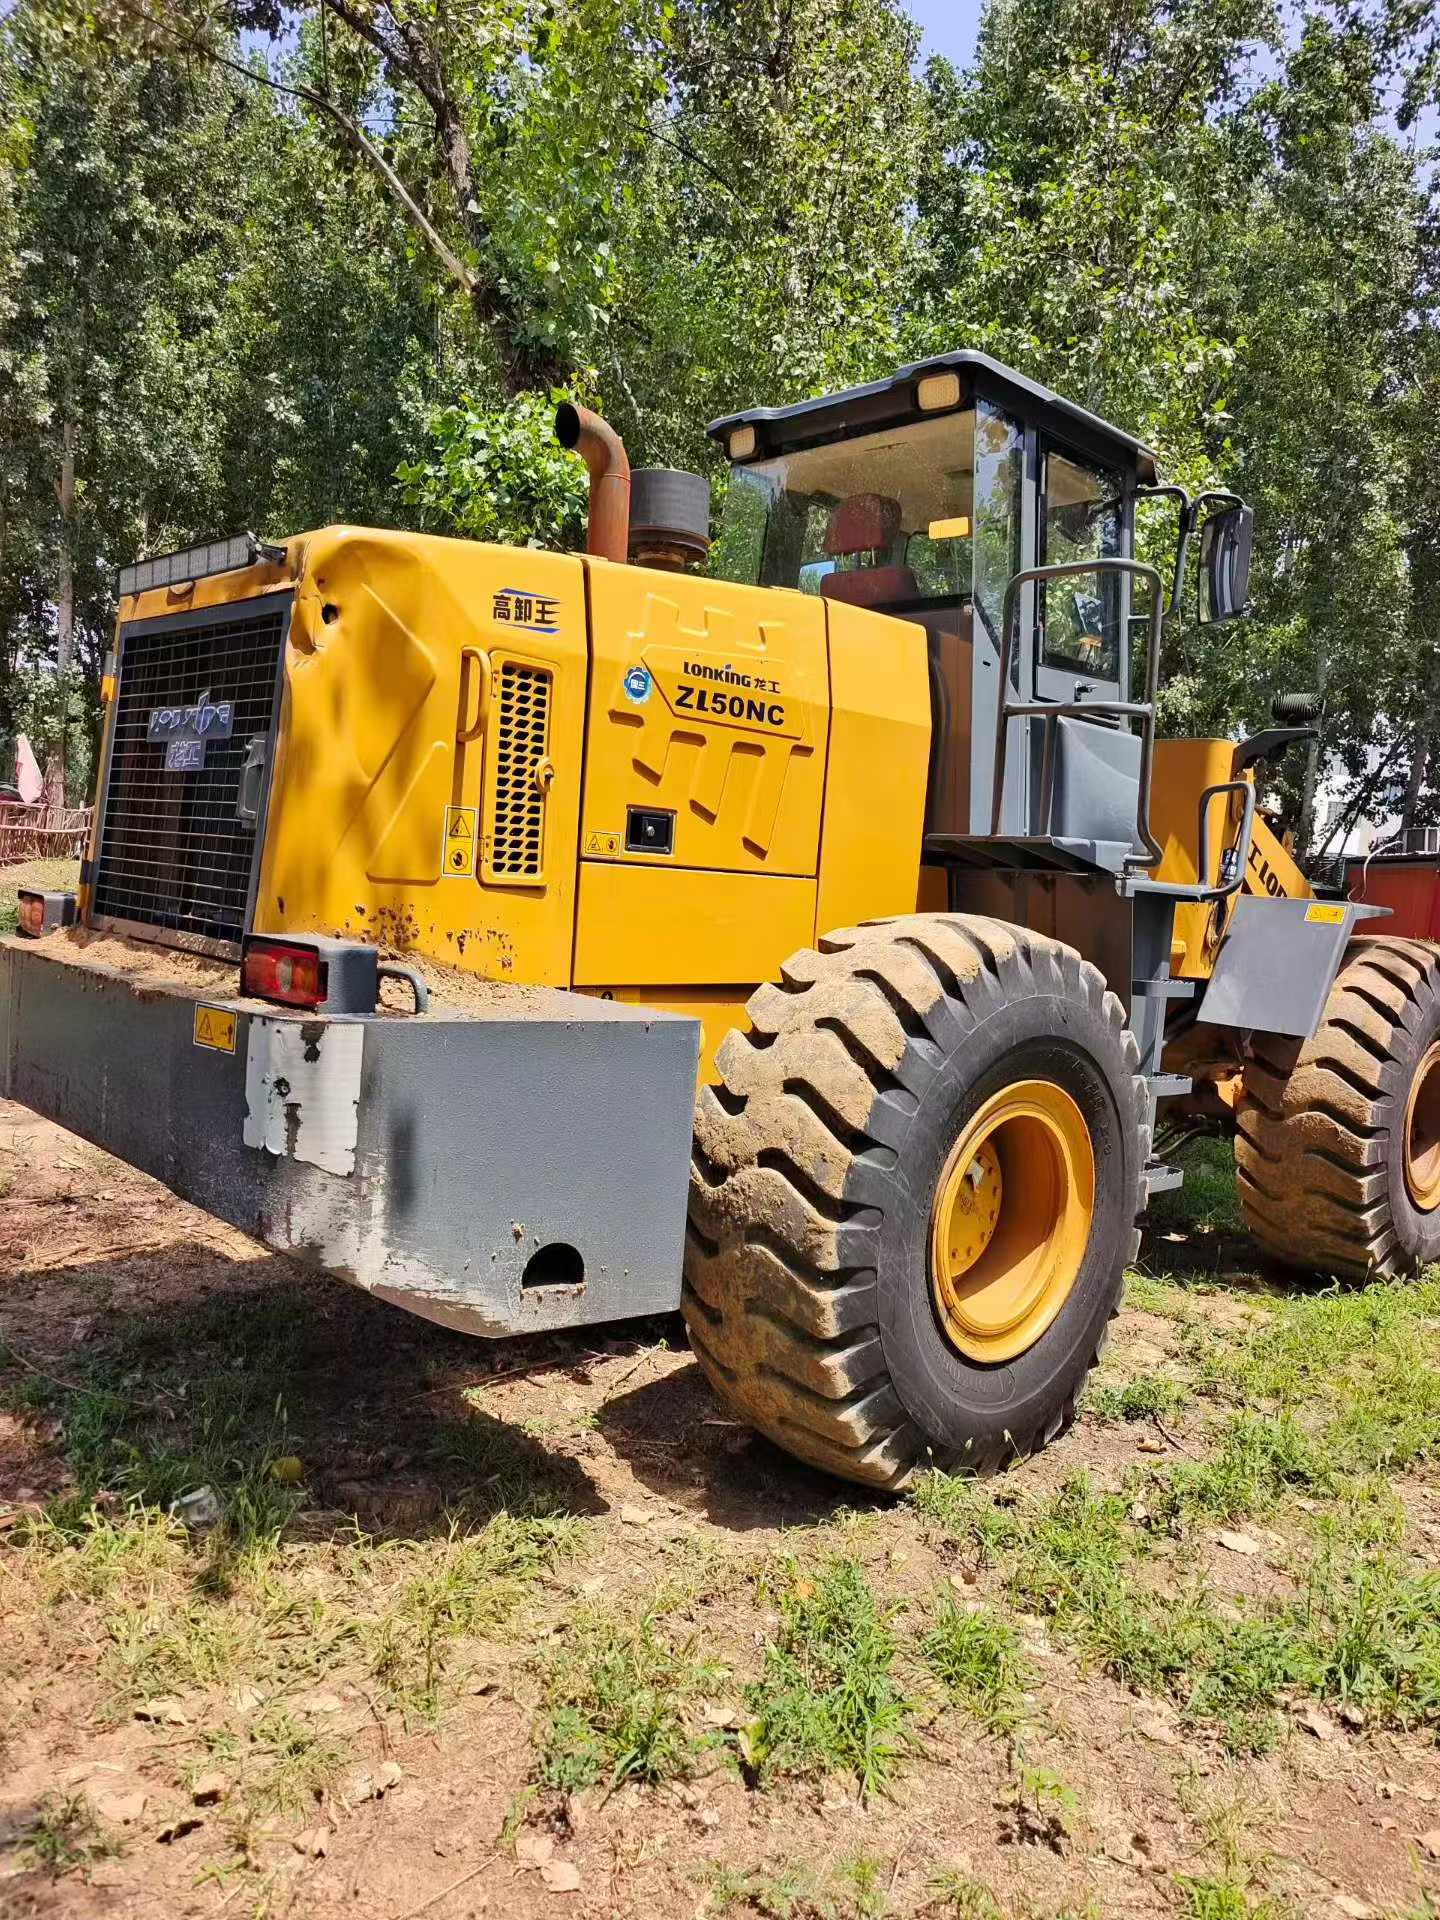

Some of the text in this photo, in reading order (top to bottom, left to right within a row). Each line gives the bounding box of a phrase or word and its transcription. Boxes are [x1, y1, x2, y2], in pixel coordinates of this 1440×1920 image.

[492, 594, 561, 625] 高卸王
[754, 677, 780, 694] 龙工
[674, 685, 785, 726] ZL50NC
